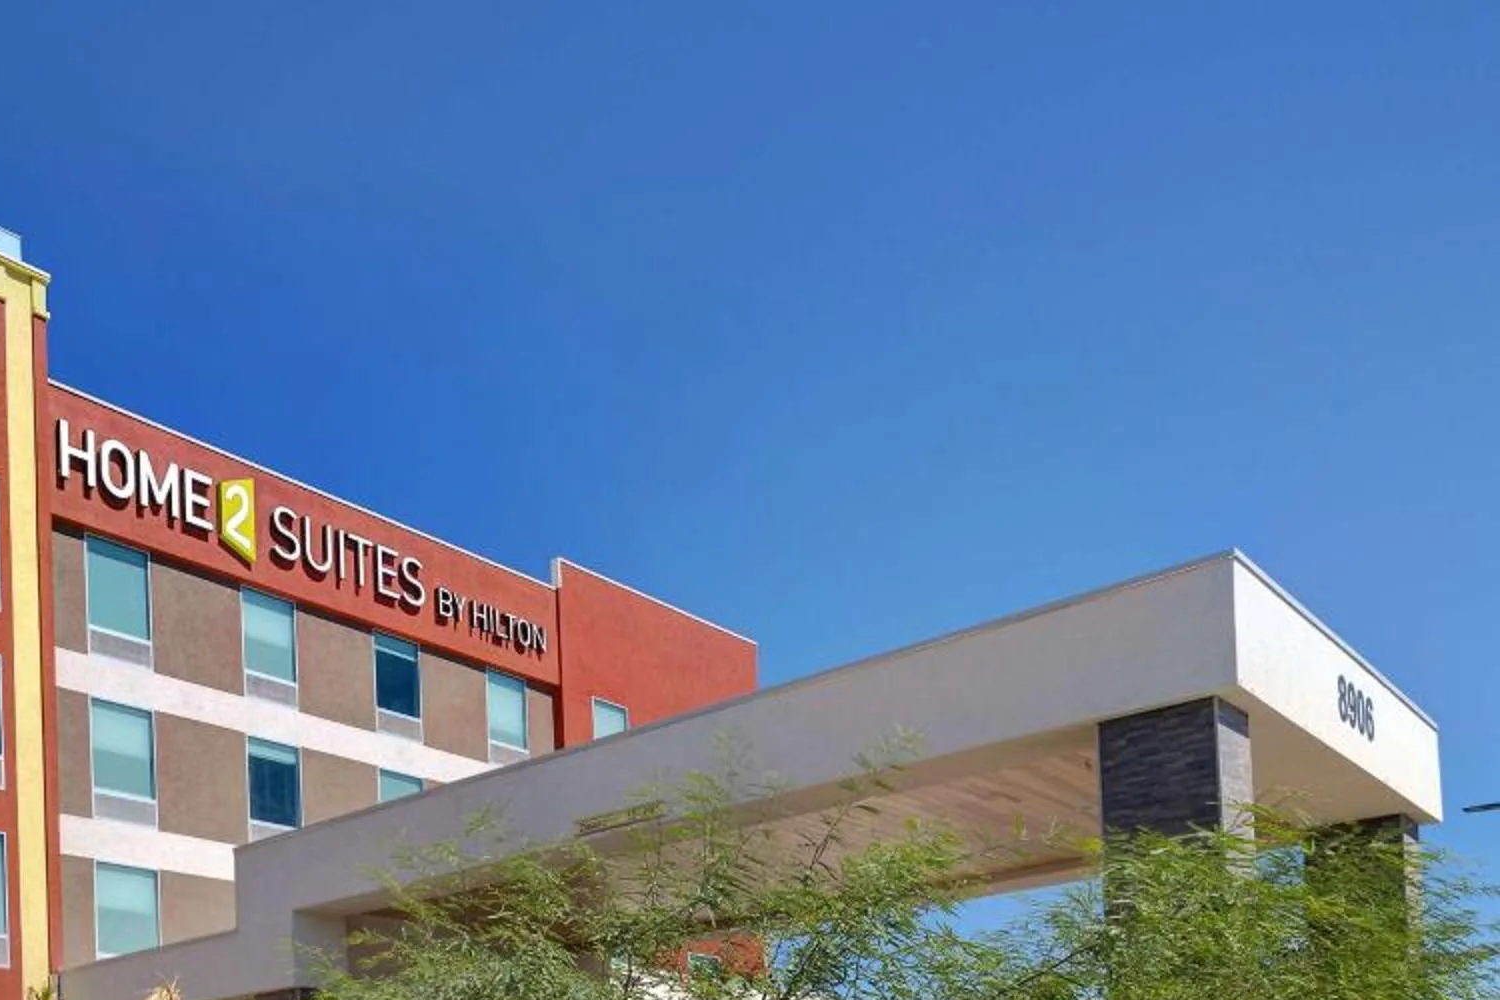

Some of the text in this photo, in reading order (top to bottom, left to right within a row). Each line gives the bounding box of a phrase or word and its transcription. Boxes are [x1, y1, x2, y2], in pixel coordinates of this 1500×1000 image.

[58, 417, 548, 654] HOME 2 SUITES BY HILTON
[1337, 674, 1375, 742] 8906
